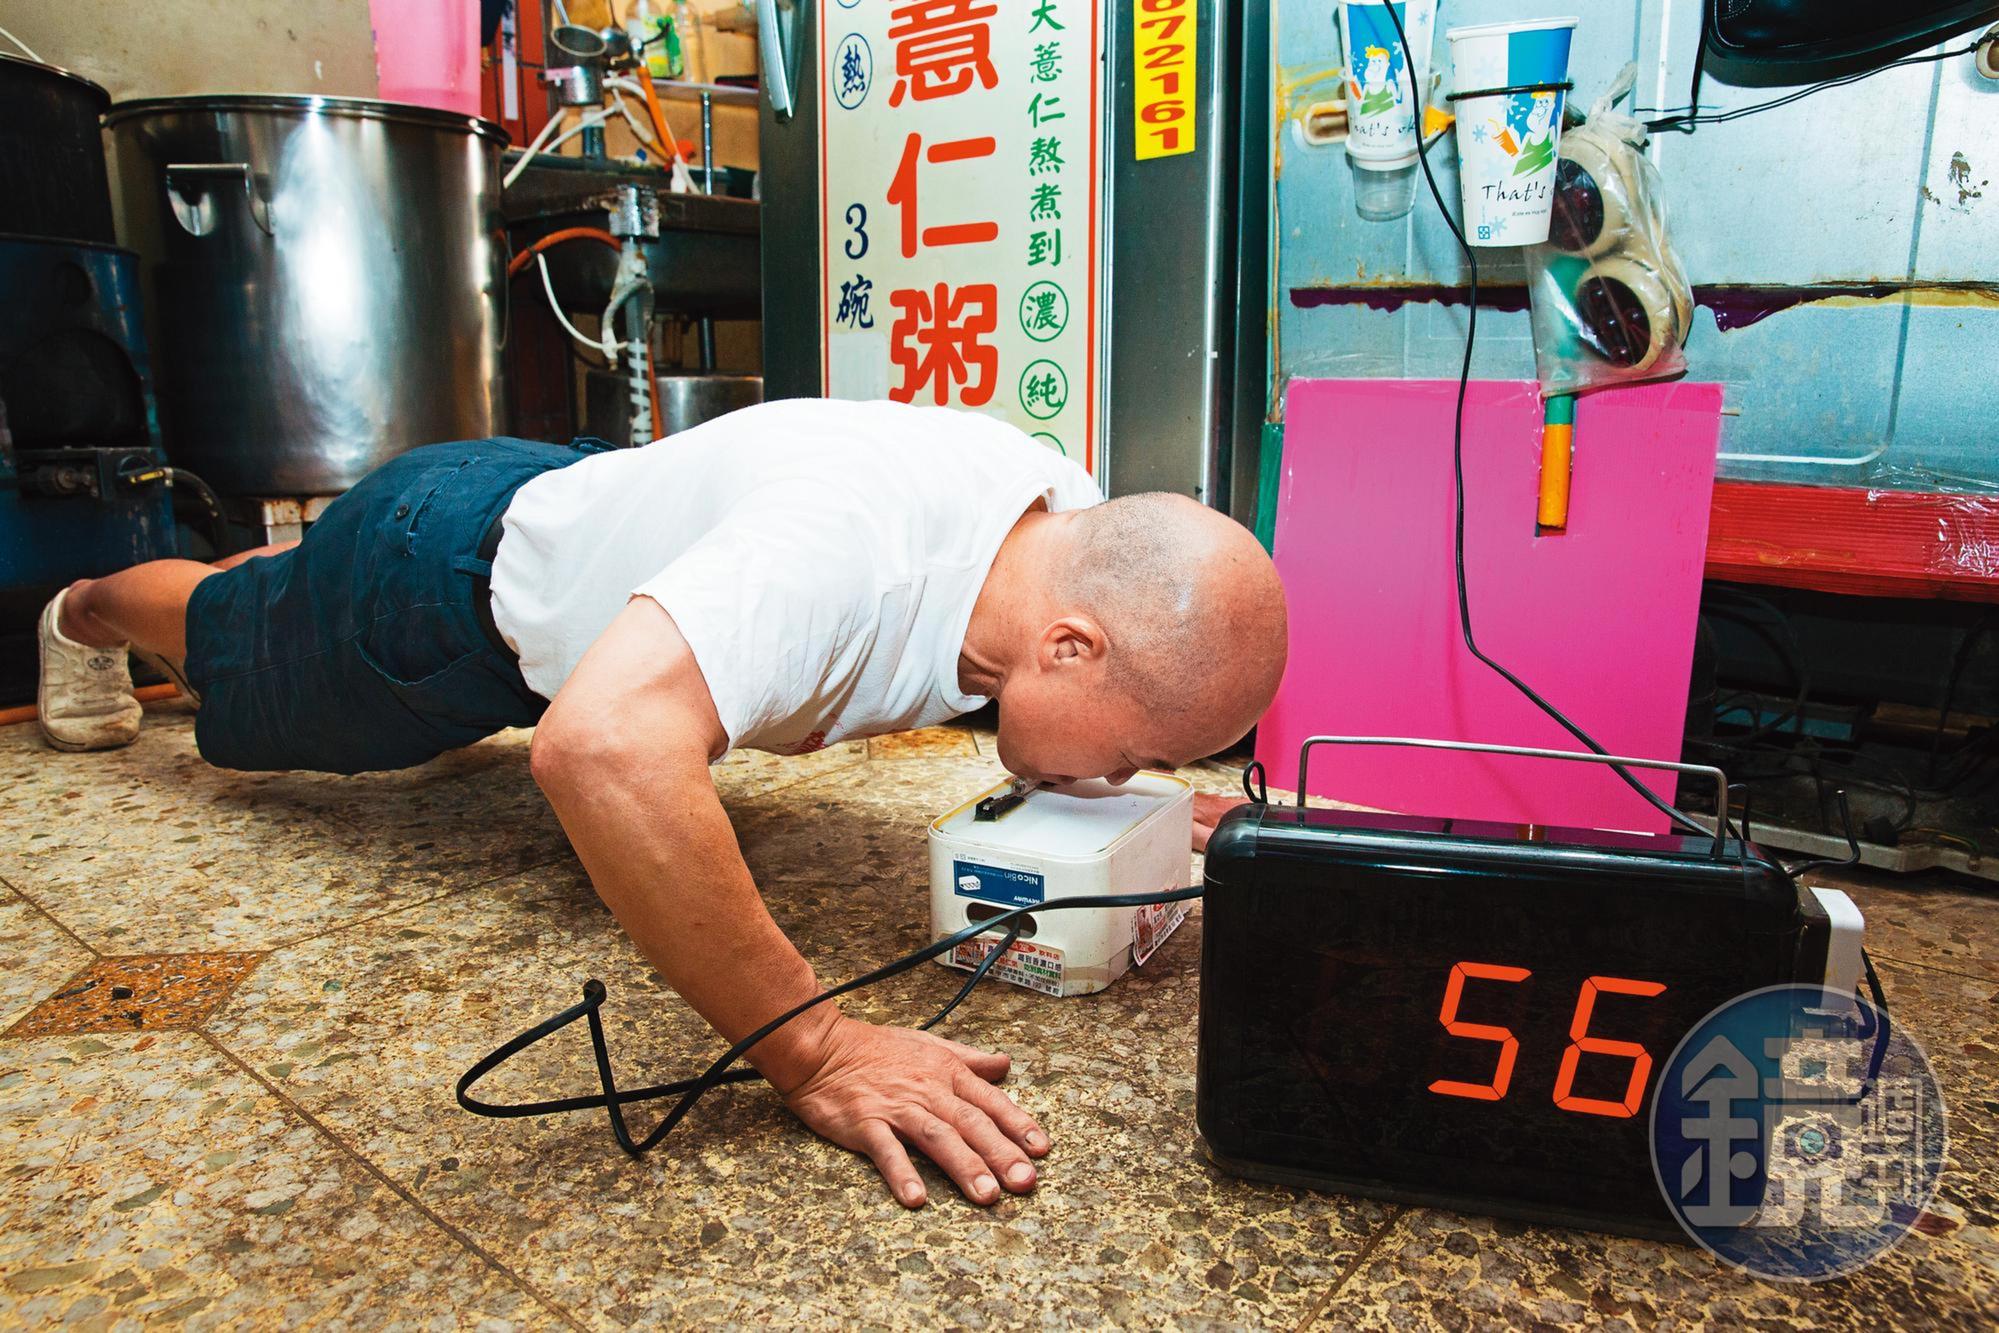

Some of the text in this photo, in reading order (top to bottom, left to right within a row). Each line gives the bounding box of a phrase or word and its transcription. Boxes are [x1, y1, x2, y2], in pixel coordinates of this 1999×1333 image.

[887, 0, 998, 407] 薏仁粥
[1481, 180, 1546, 202] That's
[1428, 961, 1668, 1119] 56
